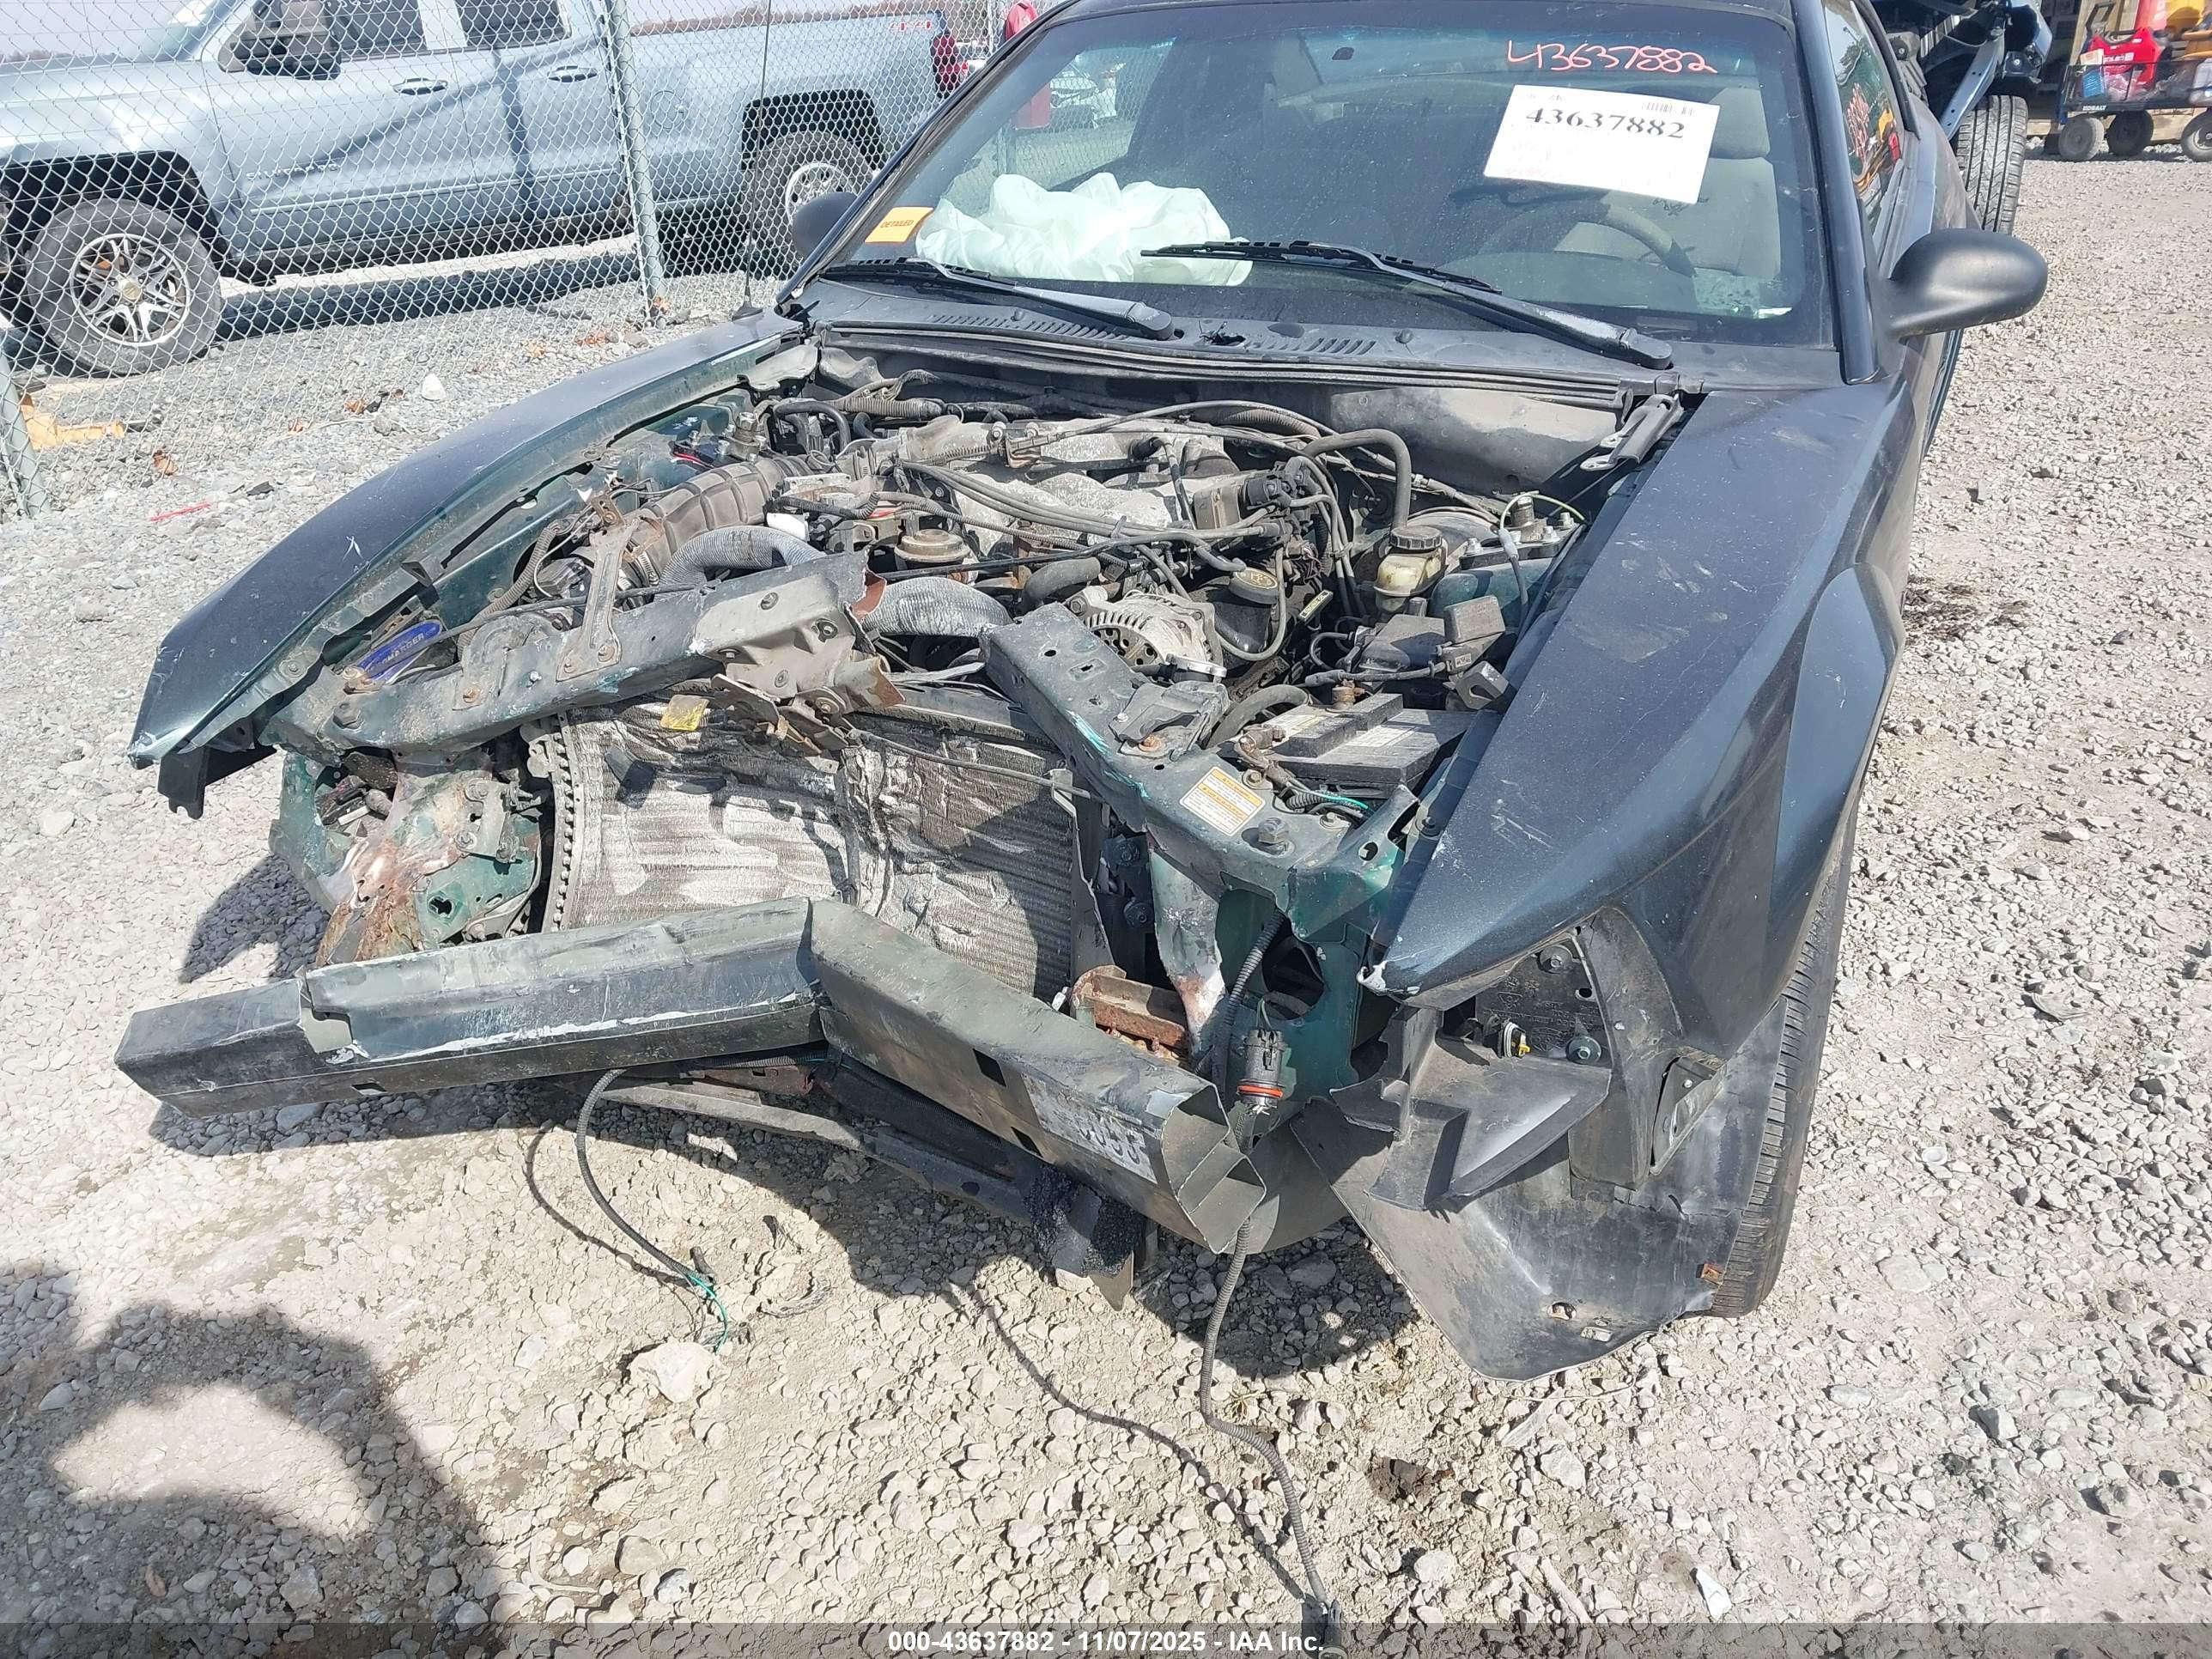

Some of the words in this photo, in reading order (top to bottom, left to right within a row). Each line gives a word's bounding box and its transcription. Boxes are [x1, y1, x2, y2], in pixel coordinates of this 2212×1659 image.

[1506, 39, 1719, 74] 43637882
[1525, 107, 1686, 139] 43637882
[880, 219, 915, 228] DETAILED
